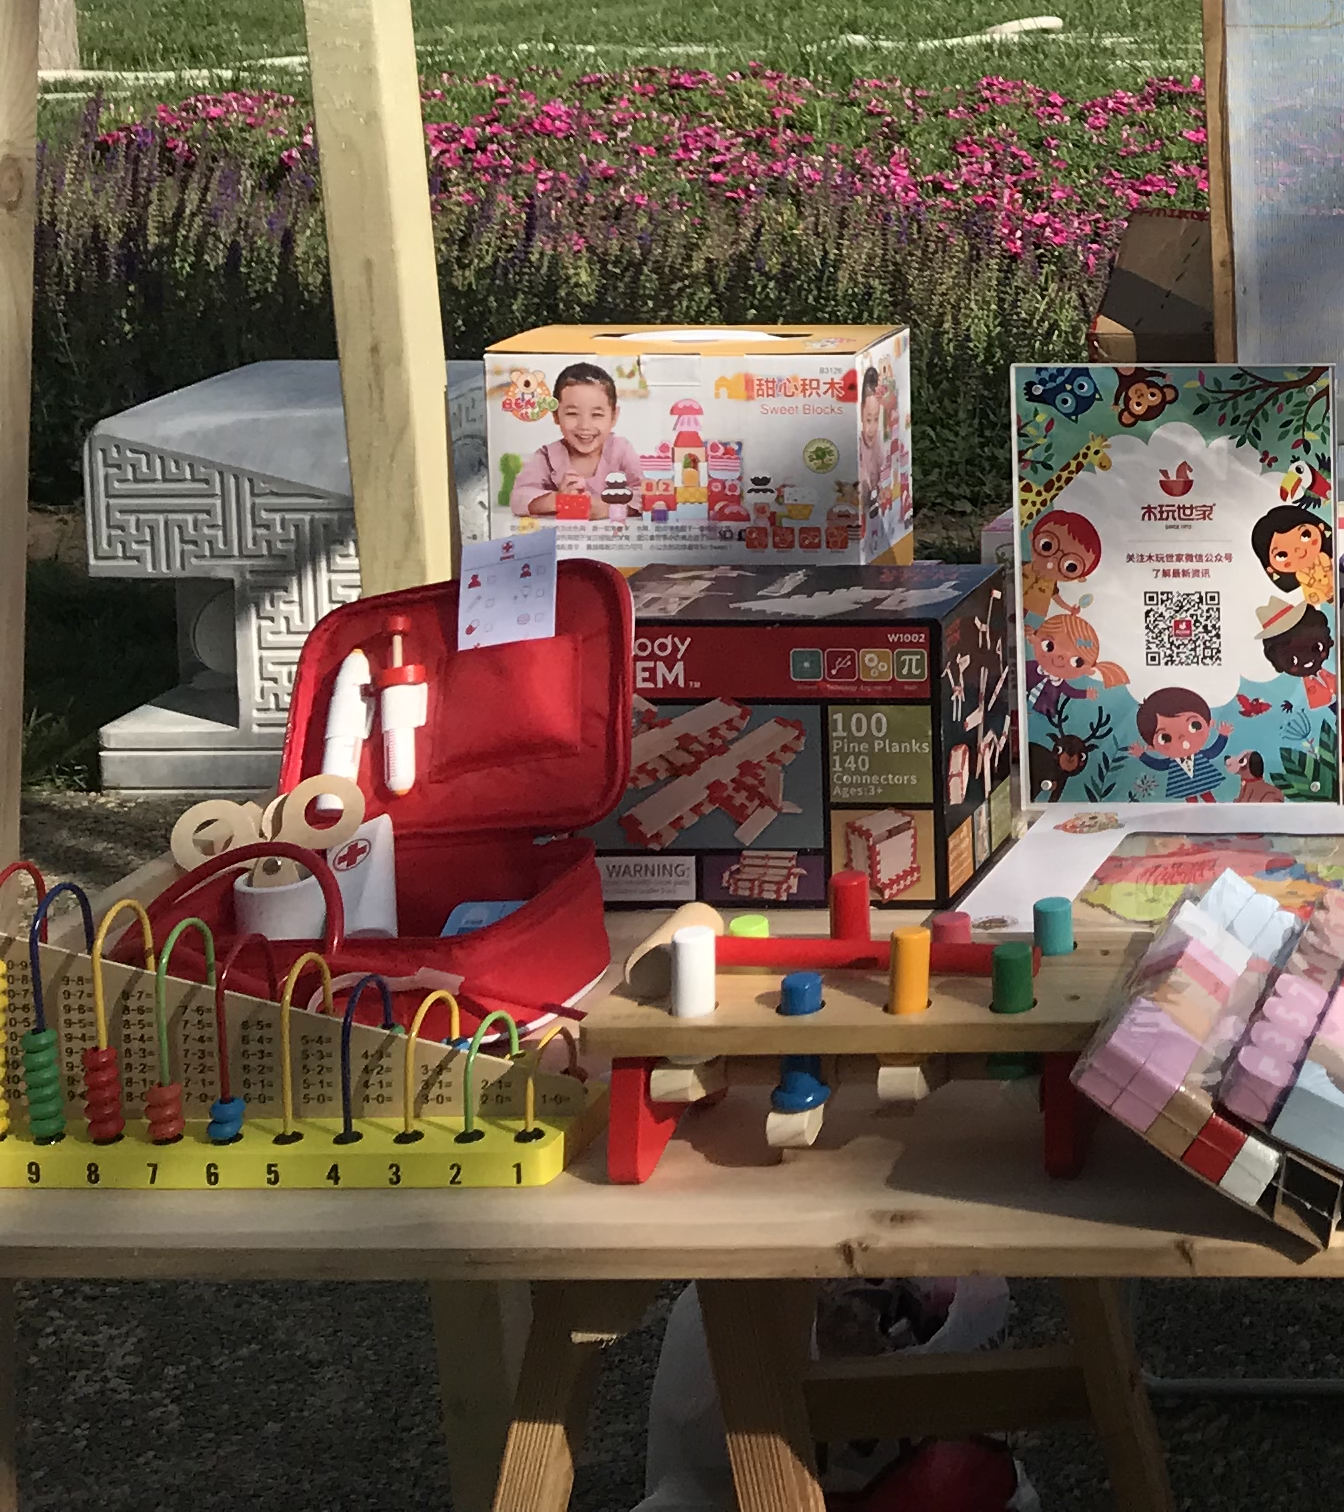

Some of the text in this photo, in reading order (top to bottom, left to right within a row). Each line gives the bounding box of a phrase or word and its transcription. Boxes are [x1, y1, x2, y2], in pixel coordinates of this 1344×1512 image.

[755, 377, 846, 399] 甜心积木
[760, 403, 844, 416] Sweet Blocks
[1140, 504, 1214, 521] 木玩世家
[1126, 553, 1233, 564] 关注木玩世家微信公众号
[887, 633, 926, 644] W1002
[833, 713, 888, 738] 100
[833, 739, 930, 753] Pine Planks
[833, 756, 870, 772] 140
[833, 772, 917, 785] Connectors
[606, 863, 690, 879] WARNING:
[27, 1162, 523, 1186] 9 8 7 6 5 4 3 2 1
